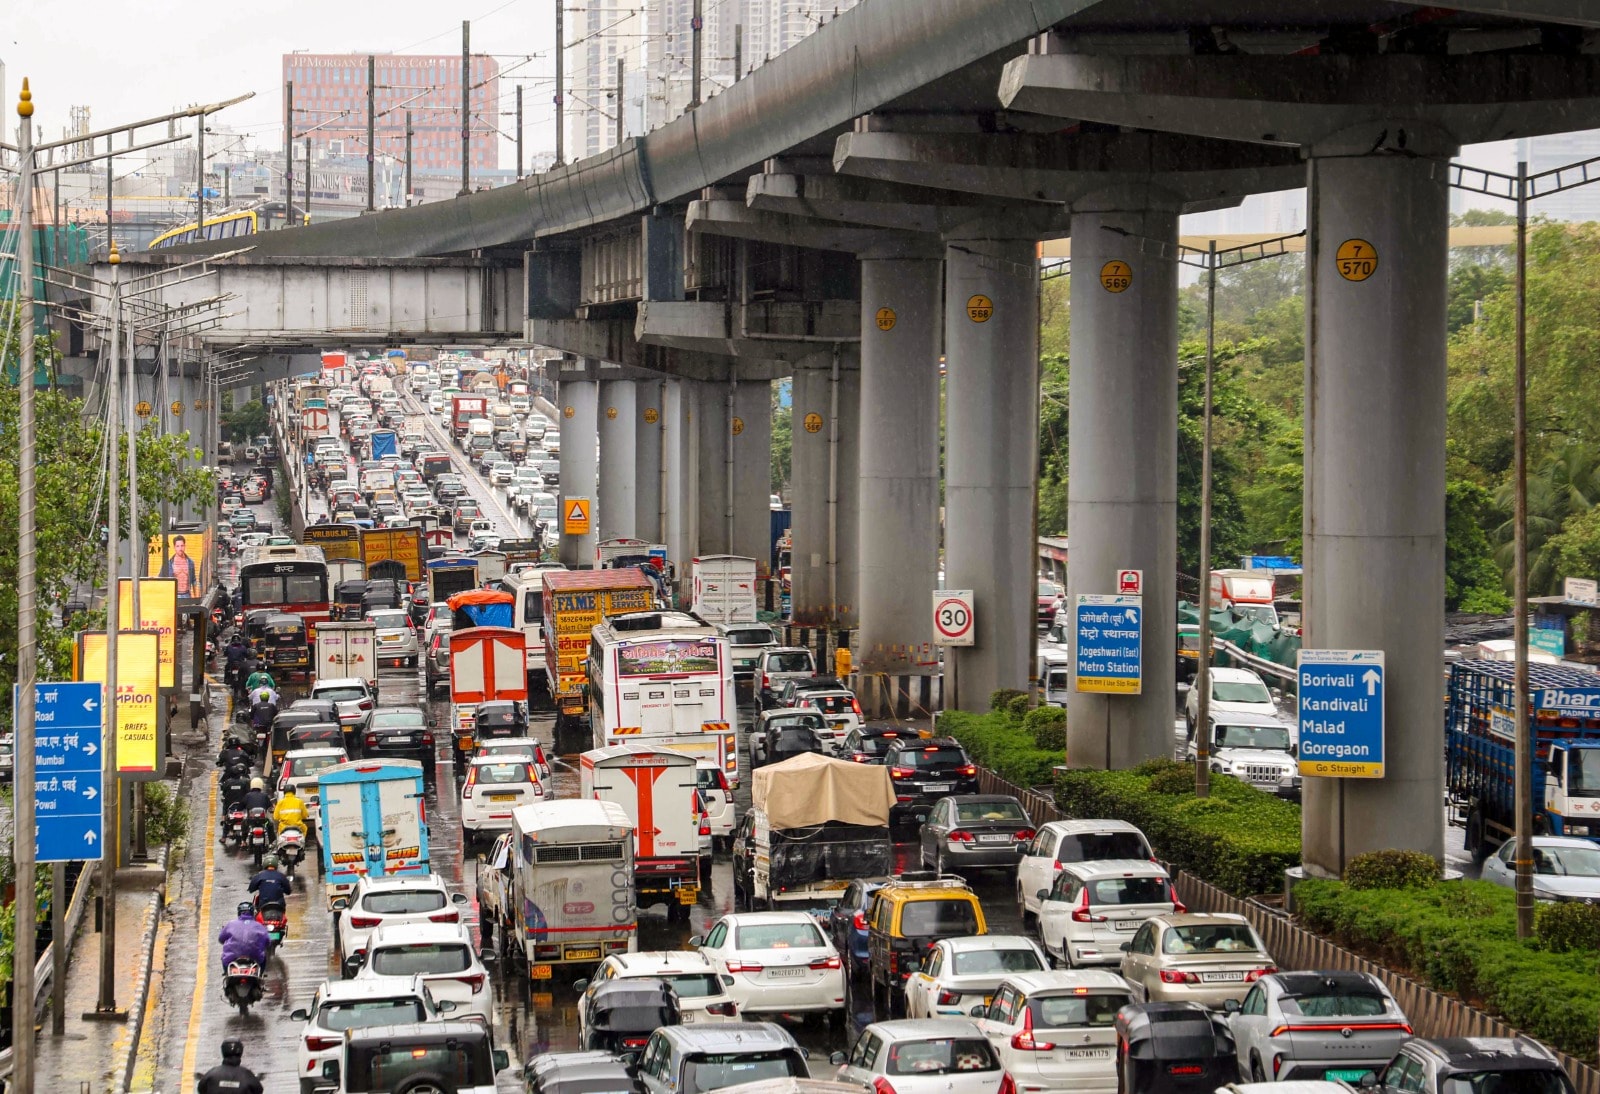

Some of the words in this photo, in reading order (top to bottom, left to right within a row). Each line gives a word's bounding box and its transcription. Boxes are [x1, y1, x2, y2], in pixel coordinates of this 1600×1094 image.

[1352, 246, 1362, 257] 7
[1113, 266, 1120, 274] 7
[1343, 262, 1370, 275] 570
[1106, 278, 1128, 288] 569
[971, 310, 988, 318] 568
[312, 530, 348, 538] VRLBUS.IN
[557, 595, 596, 611] FAME
[942, 610, 966, 626] 30
[1080, 626, 1099, 640] मेट्रो
[1103, 630, 1139, 639] स्थानक
[1080, 646, 1121, 658] Jogeshwari
[1123, 648, 1139, 658] (East)
[1080, 661, 1104, 672] Metro
[1107, 661, 1139, 673] Station
[1302, 673, 1354, 687] Borivali
[1302, 697, 1368, 712] Kandivali
[1542, 690, 1600, 708] Bhar
[35, 711, 54, 721] Road
[1302, 720, 1345, 734] Malad
[63, 732, 79, 751] मुंबई
[1302, 741, 1369, 758] Goregaon
[36, 755, 64, 765] Mumbai
[1316, 764, 1328, 772] Go
[1331, 764, 1365, 774] Straight
[62, 776, 77, 792] पवई
[35, 799, 56, 810] Powai
[387, 846, 419, 860] SIDE
